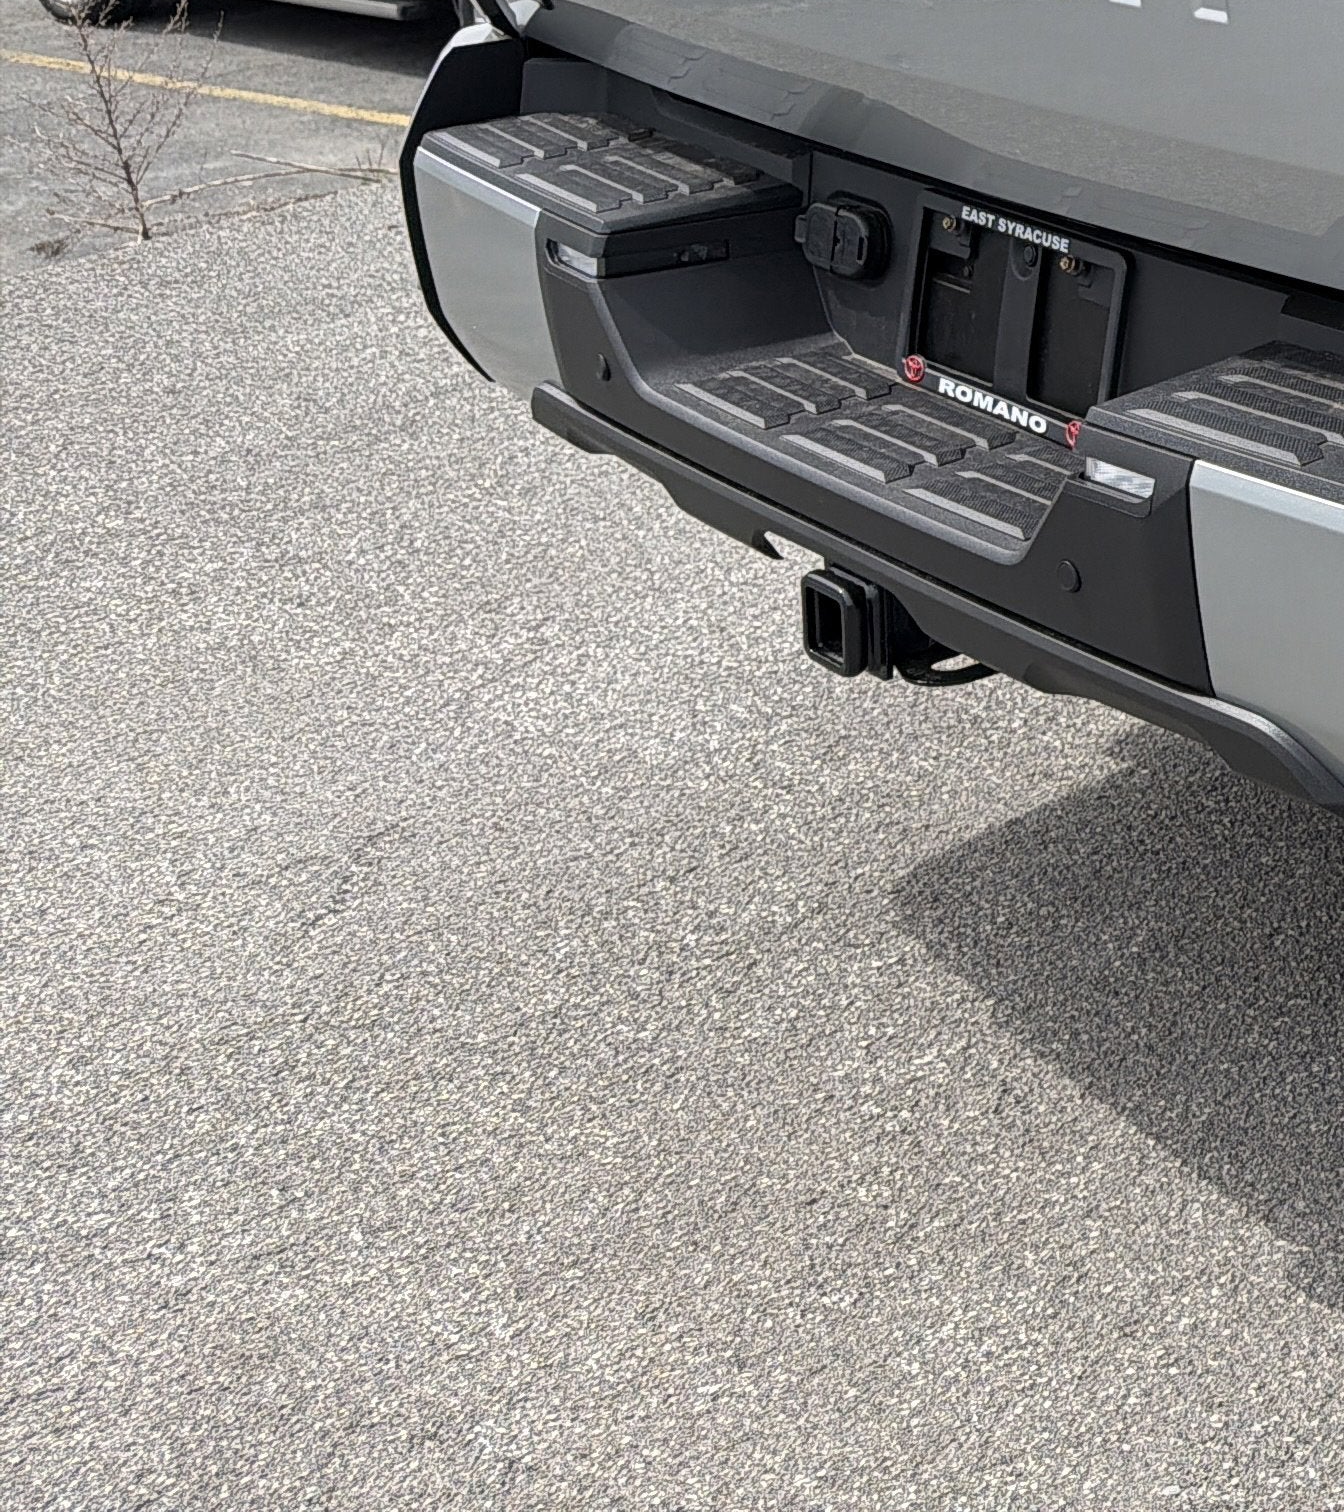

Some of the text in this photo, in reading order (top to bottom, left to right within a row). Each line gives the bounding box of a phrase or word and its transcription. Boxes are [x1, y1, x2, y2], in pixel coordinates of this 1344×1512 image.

[961, 205, 1070, 253] EAST SYRACUSE
[938, 377, 1048, 435] ROMANO
